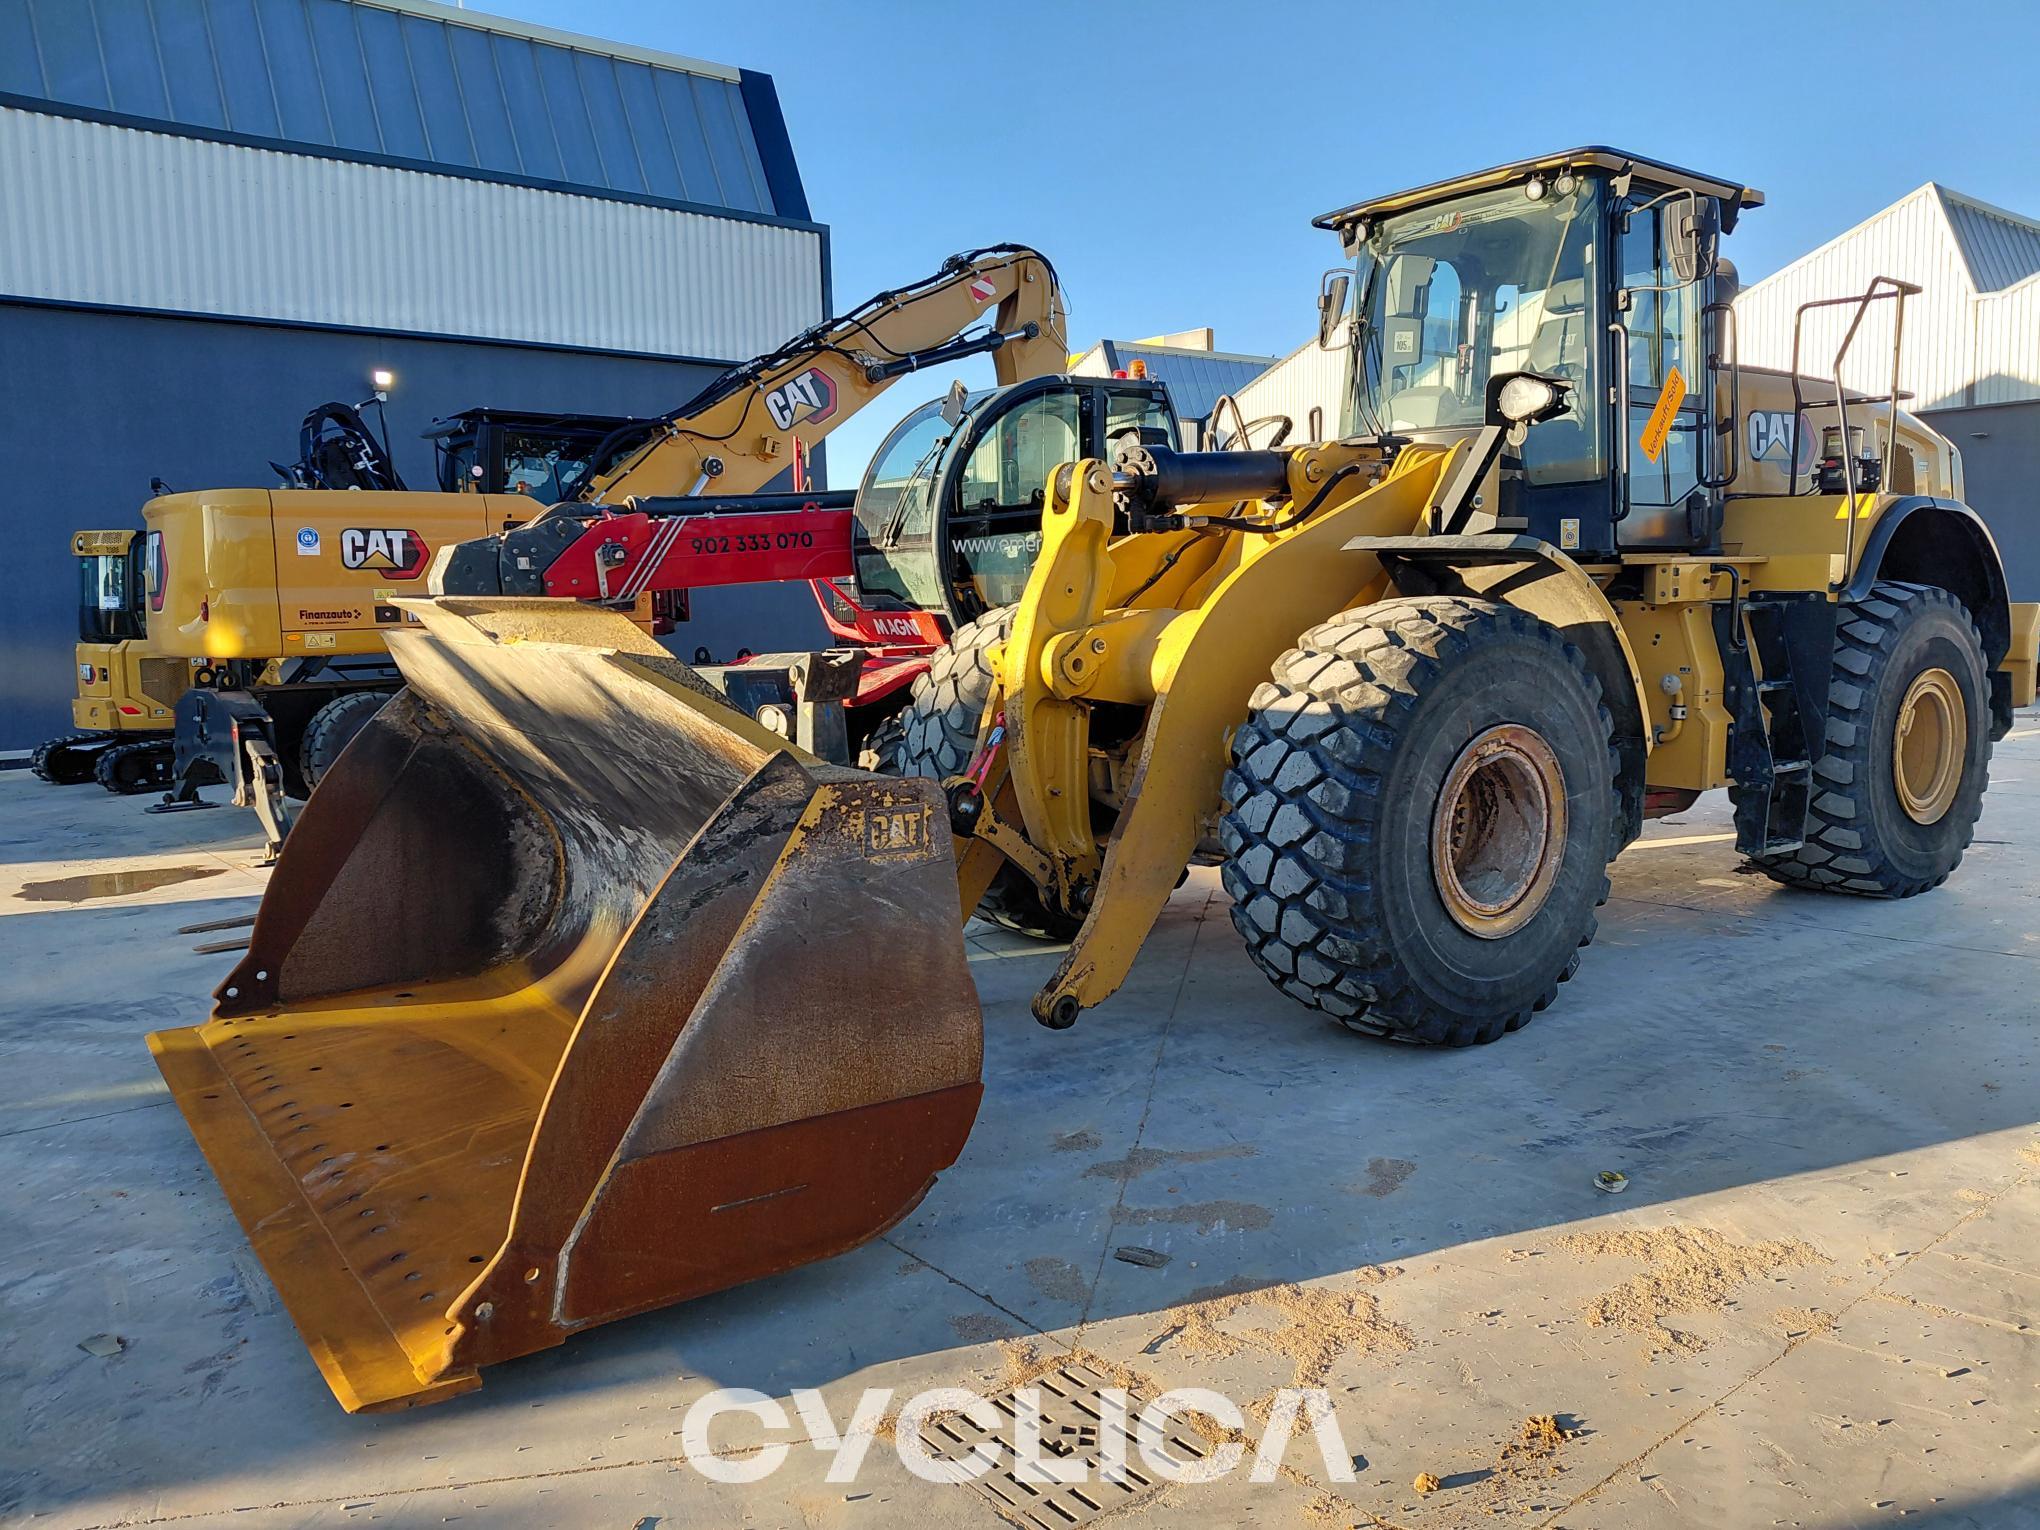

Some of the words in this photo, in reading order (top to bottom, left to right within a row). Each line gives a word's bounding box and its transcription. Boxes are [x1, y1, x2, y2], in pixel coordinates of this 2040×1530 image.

[765, 371, 822, 430] CAT
[1647, 372, 1681, 455] Verkauft/Sold
[1750, 411, 1795, 460] CAT
[341, 529, 408, 569] CAT
[691, 537, 731, 554] 902
[736, 534, 771, 551] 333
[776, 532, 814, 549] 070
[299, 608, 353, 620] Finanzauto
[873, 618, 923, 636] MAGNI
[870, 812, 922, 851] CAT
